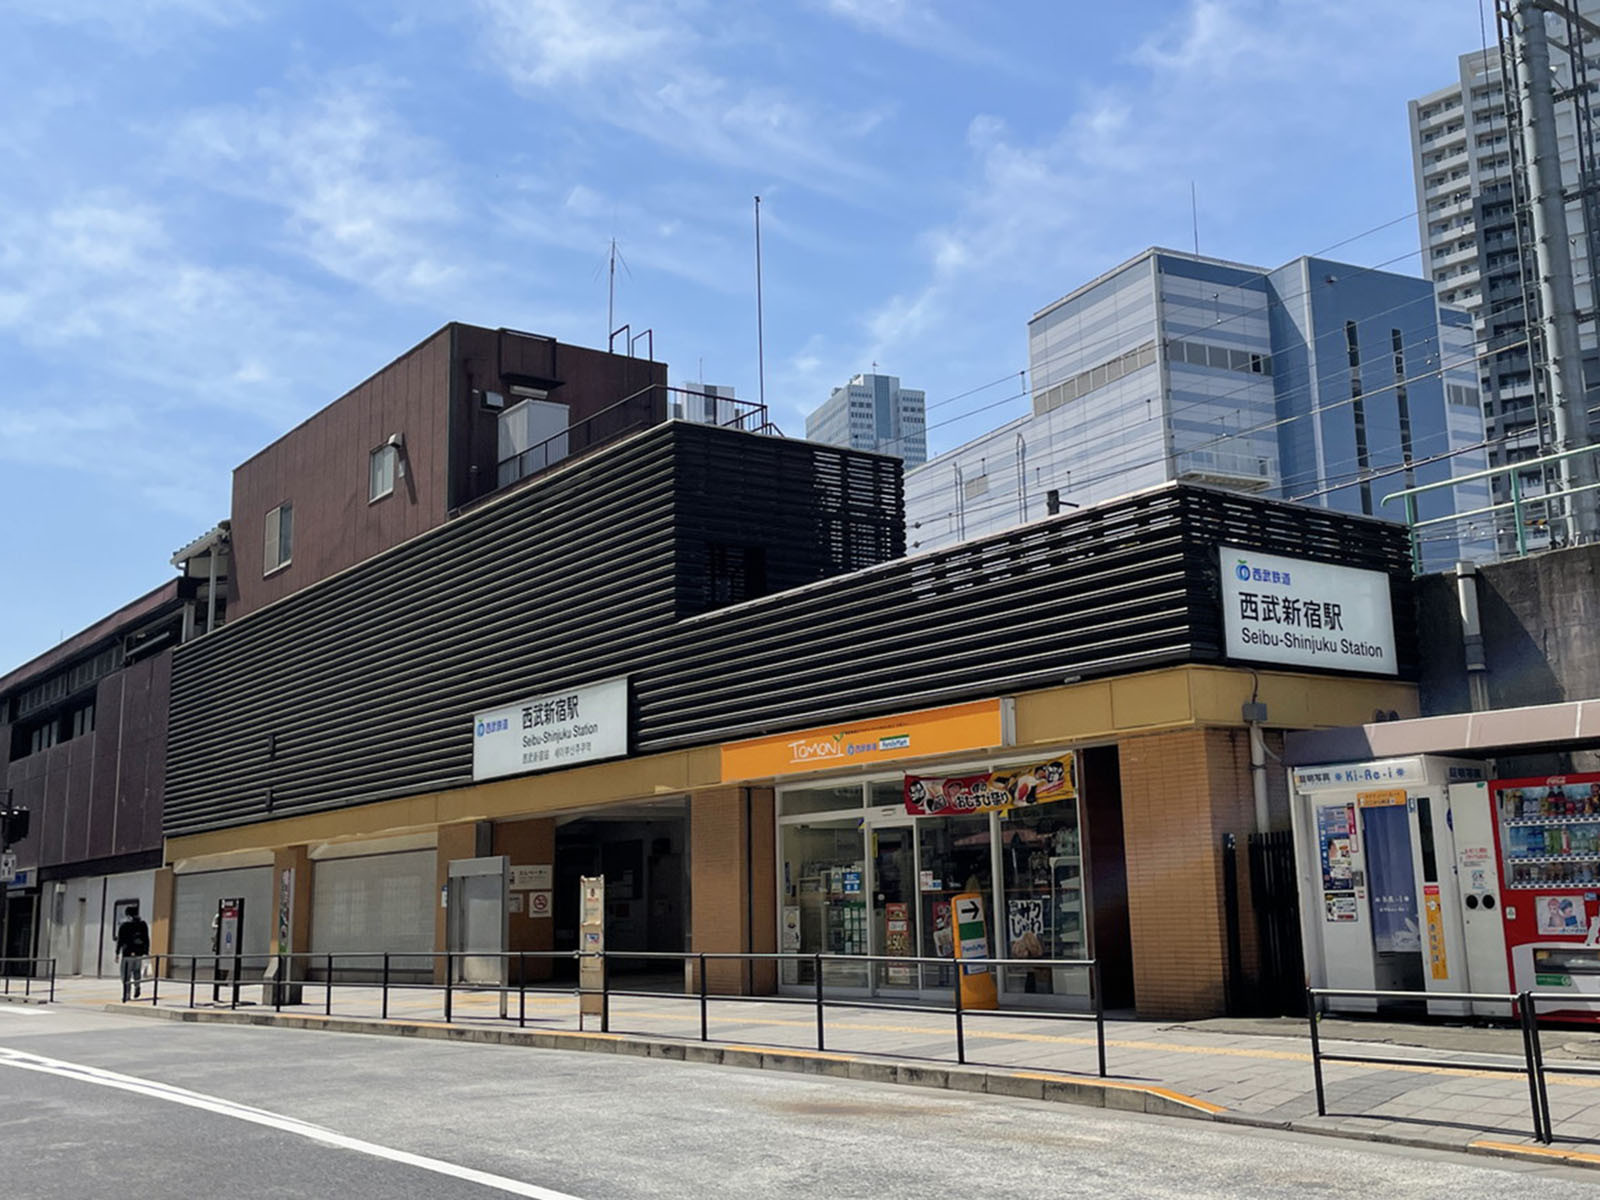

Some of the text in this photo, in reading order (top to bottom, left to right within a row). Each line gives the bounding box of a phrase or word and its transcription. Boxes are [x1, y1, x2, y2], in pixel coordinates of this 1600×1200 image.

[1252, 567, 1291, 586] 西武鉄道
[1238, 591, 1343, 631] 西武新宿駅
[1241, 627, 1383, 658] Seibu-Shinjuku Station
[522, 695, 579, 730] 西武新宿駅
[522, 723, 598, 748] Seibu-Shinjuku Station
